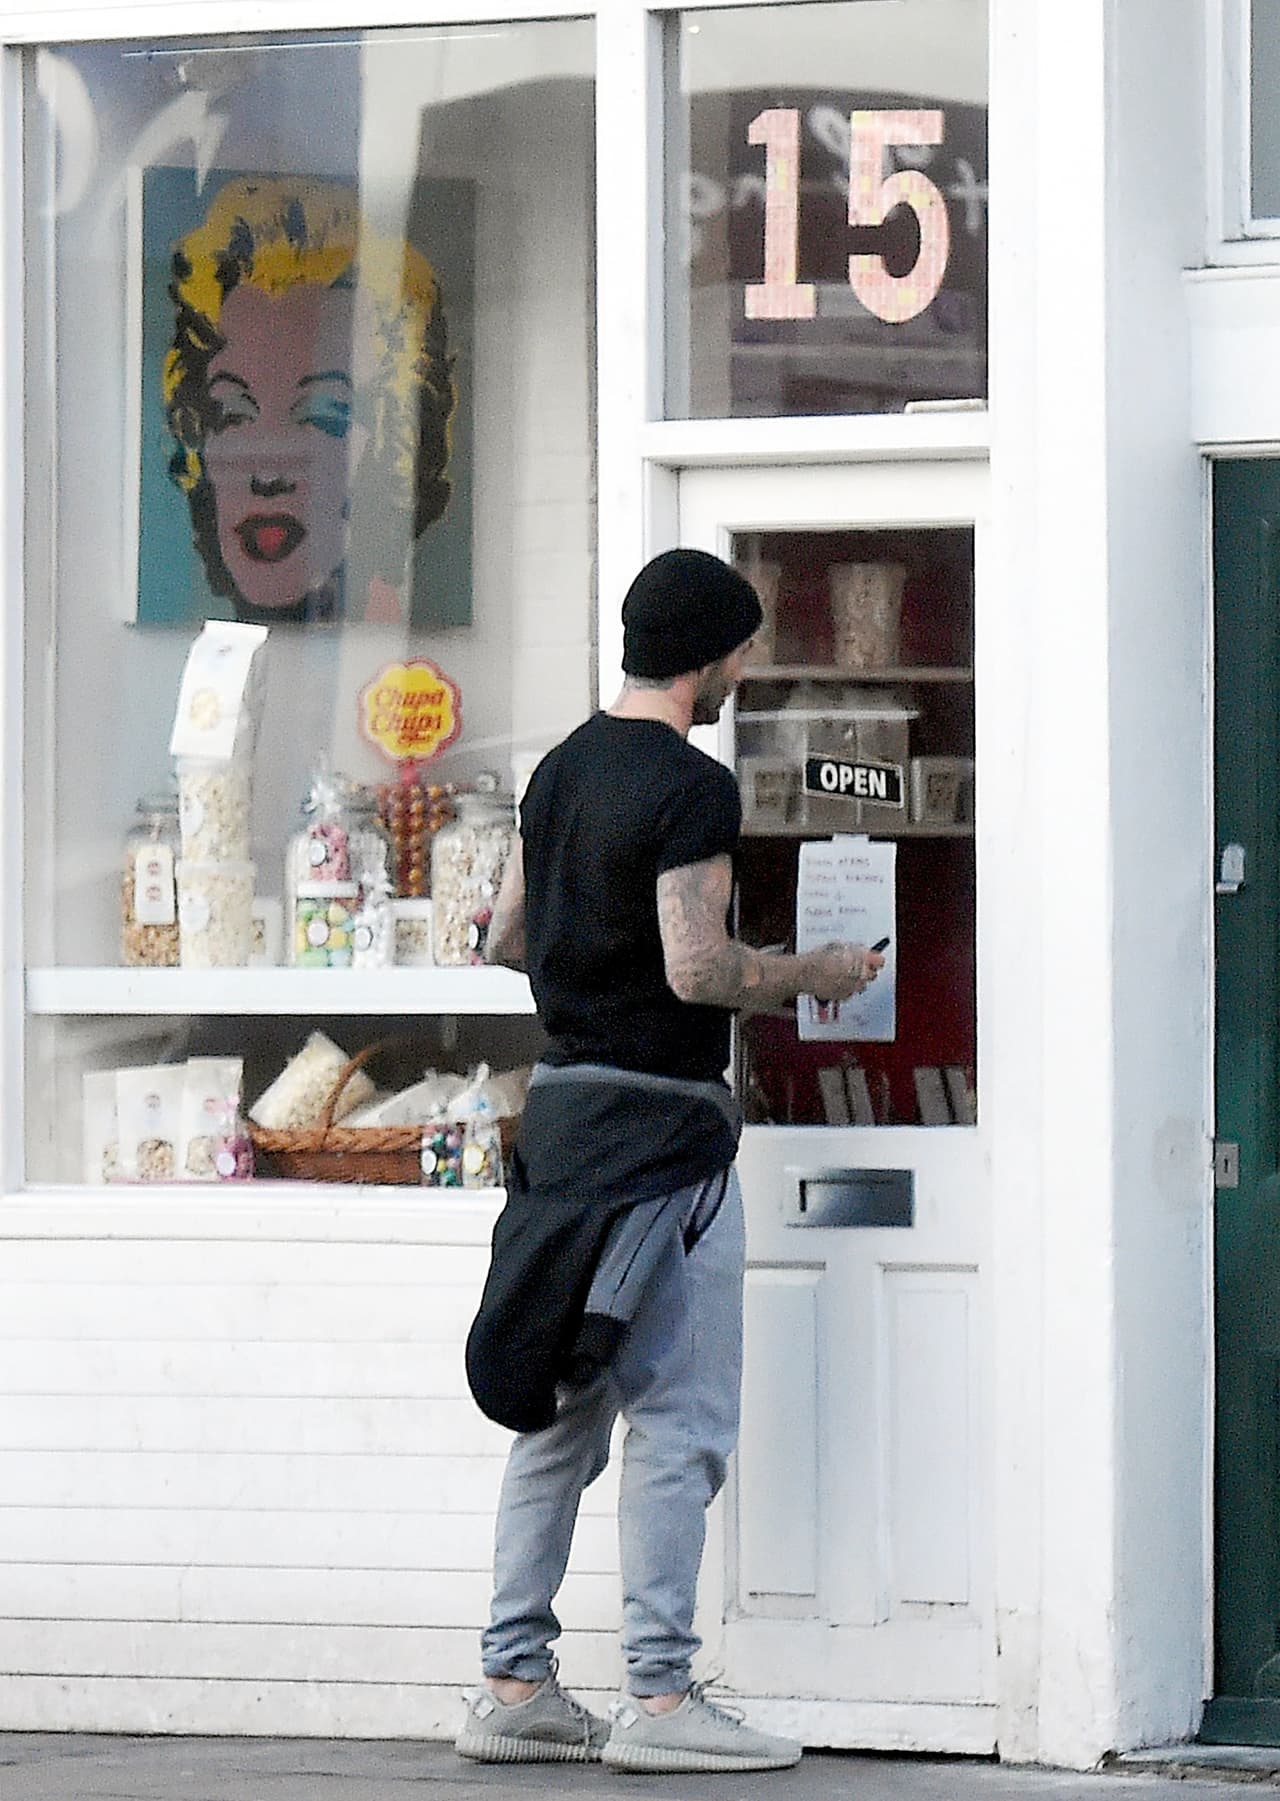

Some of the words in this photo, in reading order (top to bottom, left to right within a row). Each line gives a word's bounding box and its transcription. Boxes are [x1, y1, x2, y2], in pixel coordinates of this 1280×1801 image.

[744, 108, 949, 324] 15
[375, 688, 445, 711] Chupa
[820, 762, 887, 799] OPEN
